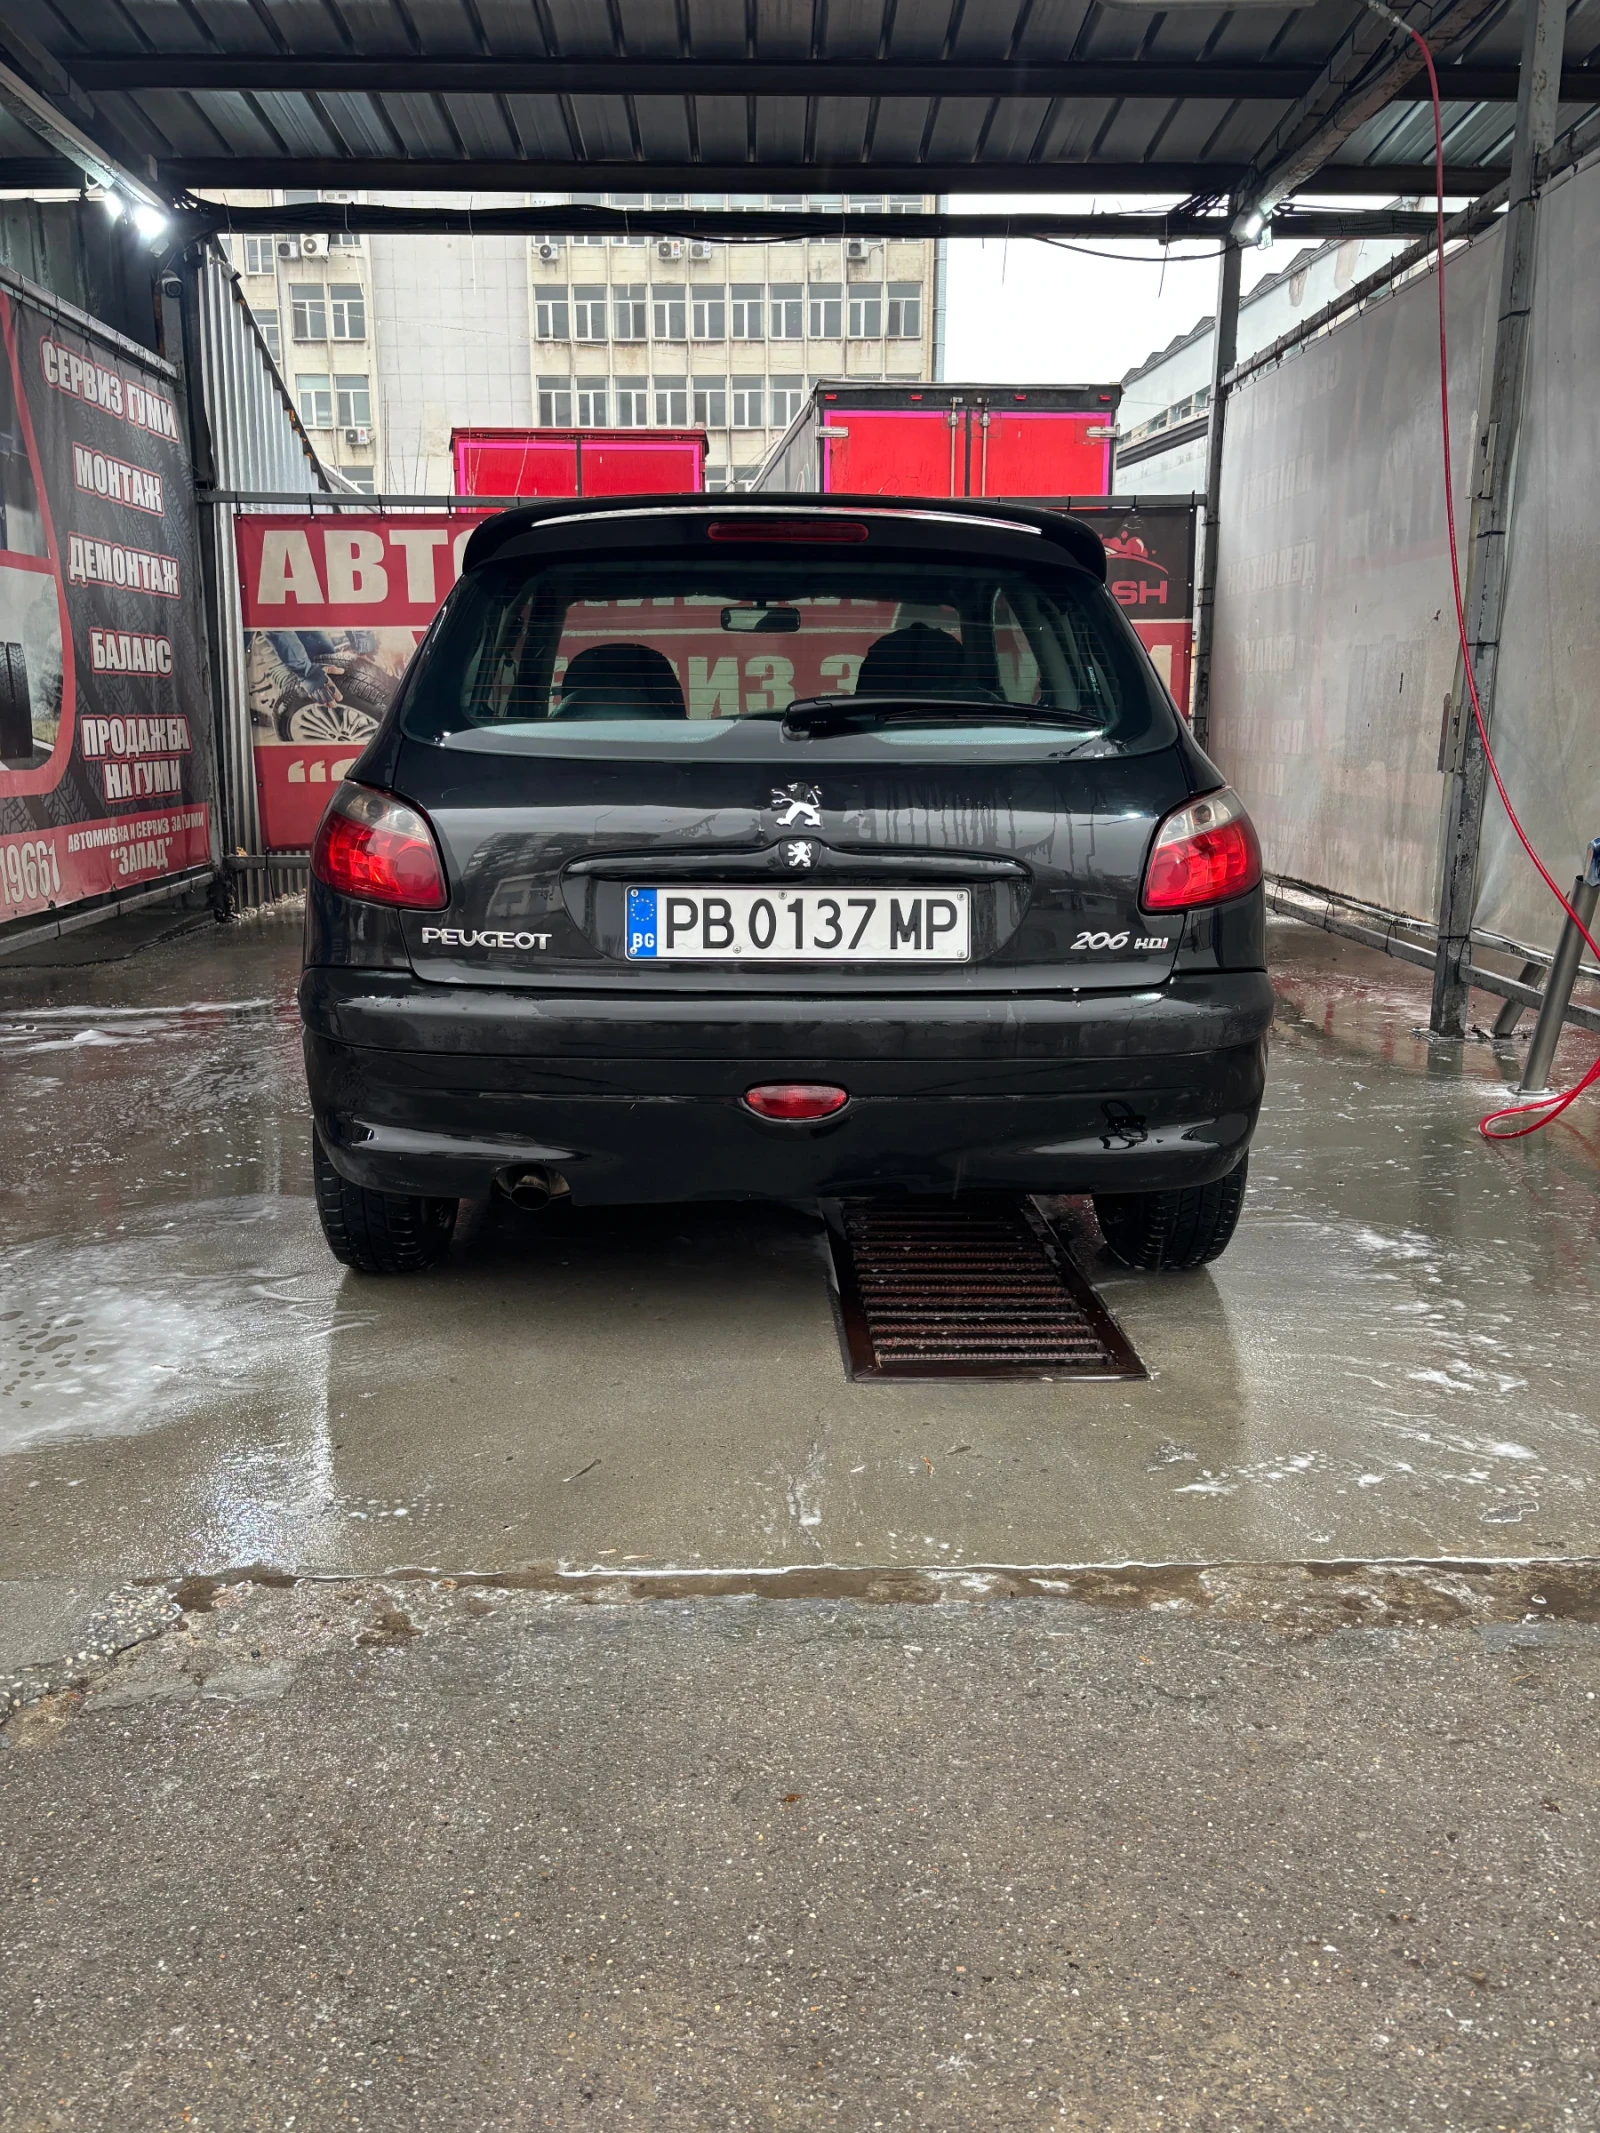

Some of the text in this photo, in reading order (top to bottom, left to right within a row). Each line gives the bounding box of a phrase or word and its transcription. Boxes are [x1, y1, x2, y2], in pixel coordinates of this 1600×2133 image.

[41, 340, 179, 441] СЕРВИЗ ГУМИ
[73, 445, 165, 514] МОНТАЖ
[68, 535, 180, 597] ДЕМОНТАЖ
[257, 528, 474, 605] АВТ
[90, 631, 173, 675] БАЛАНС
[81, 717, 191, 759] ПРОДАЖБА
[104, 759, 181, 800] НА ГУМИ
[67, 824, 130, 853] АВТОМИВКА
[136, 817, 170, 839] СЕРВИЗ
[171, 815, 182, 833] ЗА
[420, 926, 553, 950] PEUGEOT
[631, 932, 656, 949] BG
[665, 897, 958, 950] PB 0137 MP
[1069, 930, 1131, 950] 206
